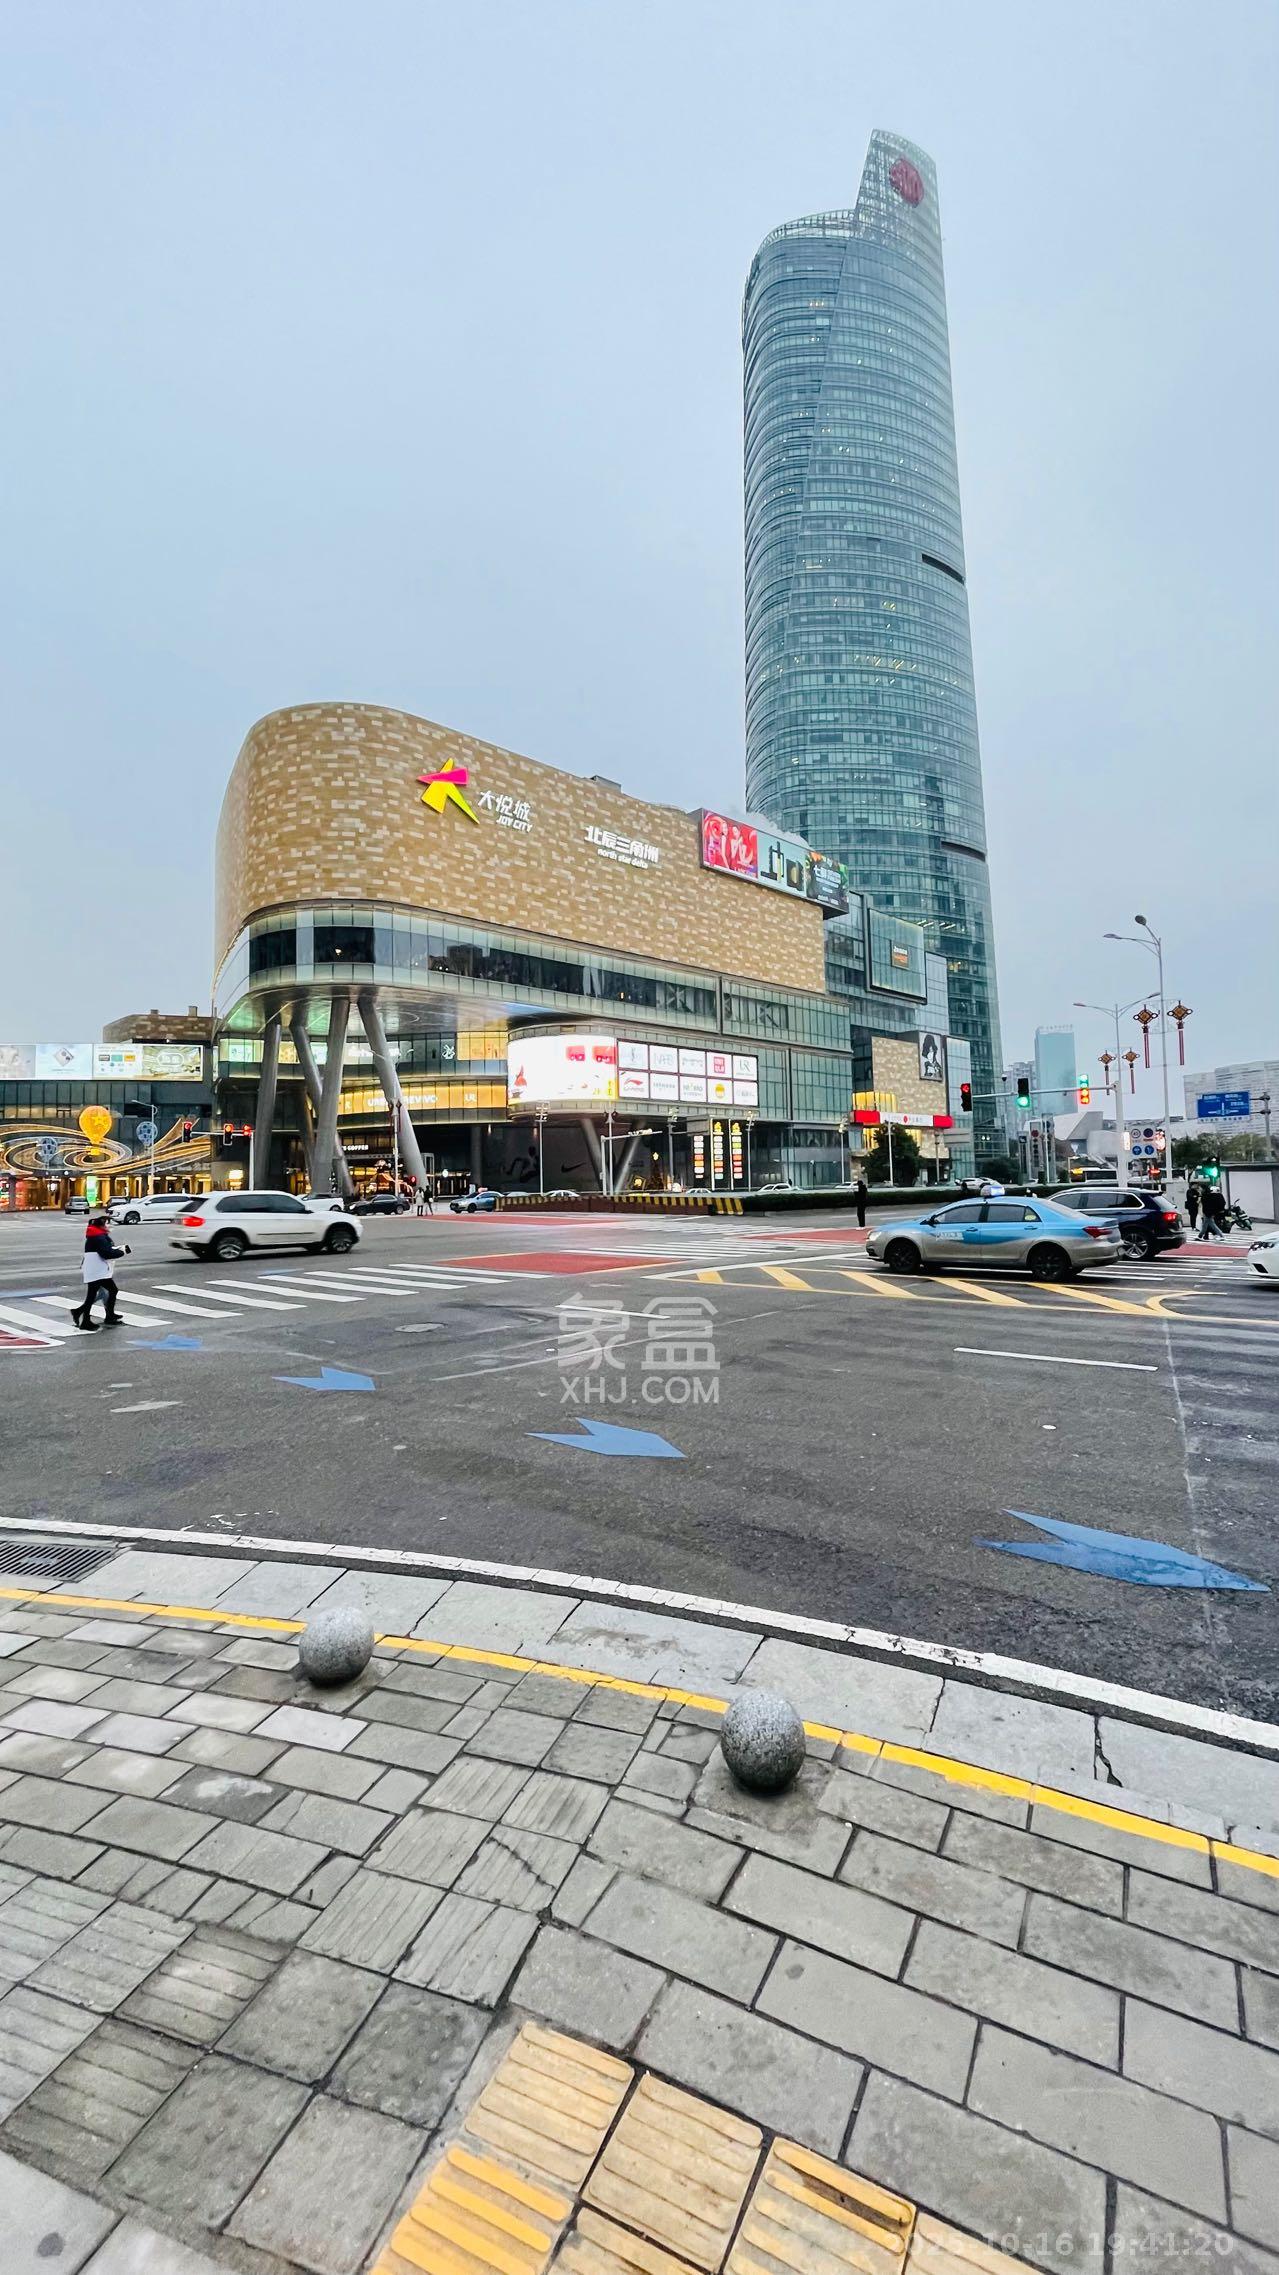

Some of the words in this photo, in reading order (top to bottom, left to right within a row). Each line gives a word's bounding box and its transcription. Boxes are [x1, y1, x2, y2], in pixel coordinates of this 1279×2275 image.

[478, 790, 531, 822] 大悦城
[496, 815, 514, 827] JOY
[512, 819, 533, 833] CITY
[584, 825, 660, 864] 北辰三角洲
